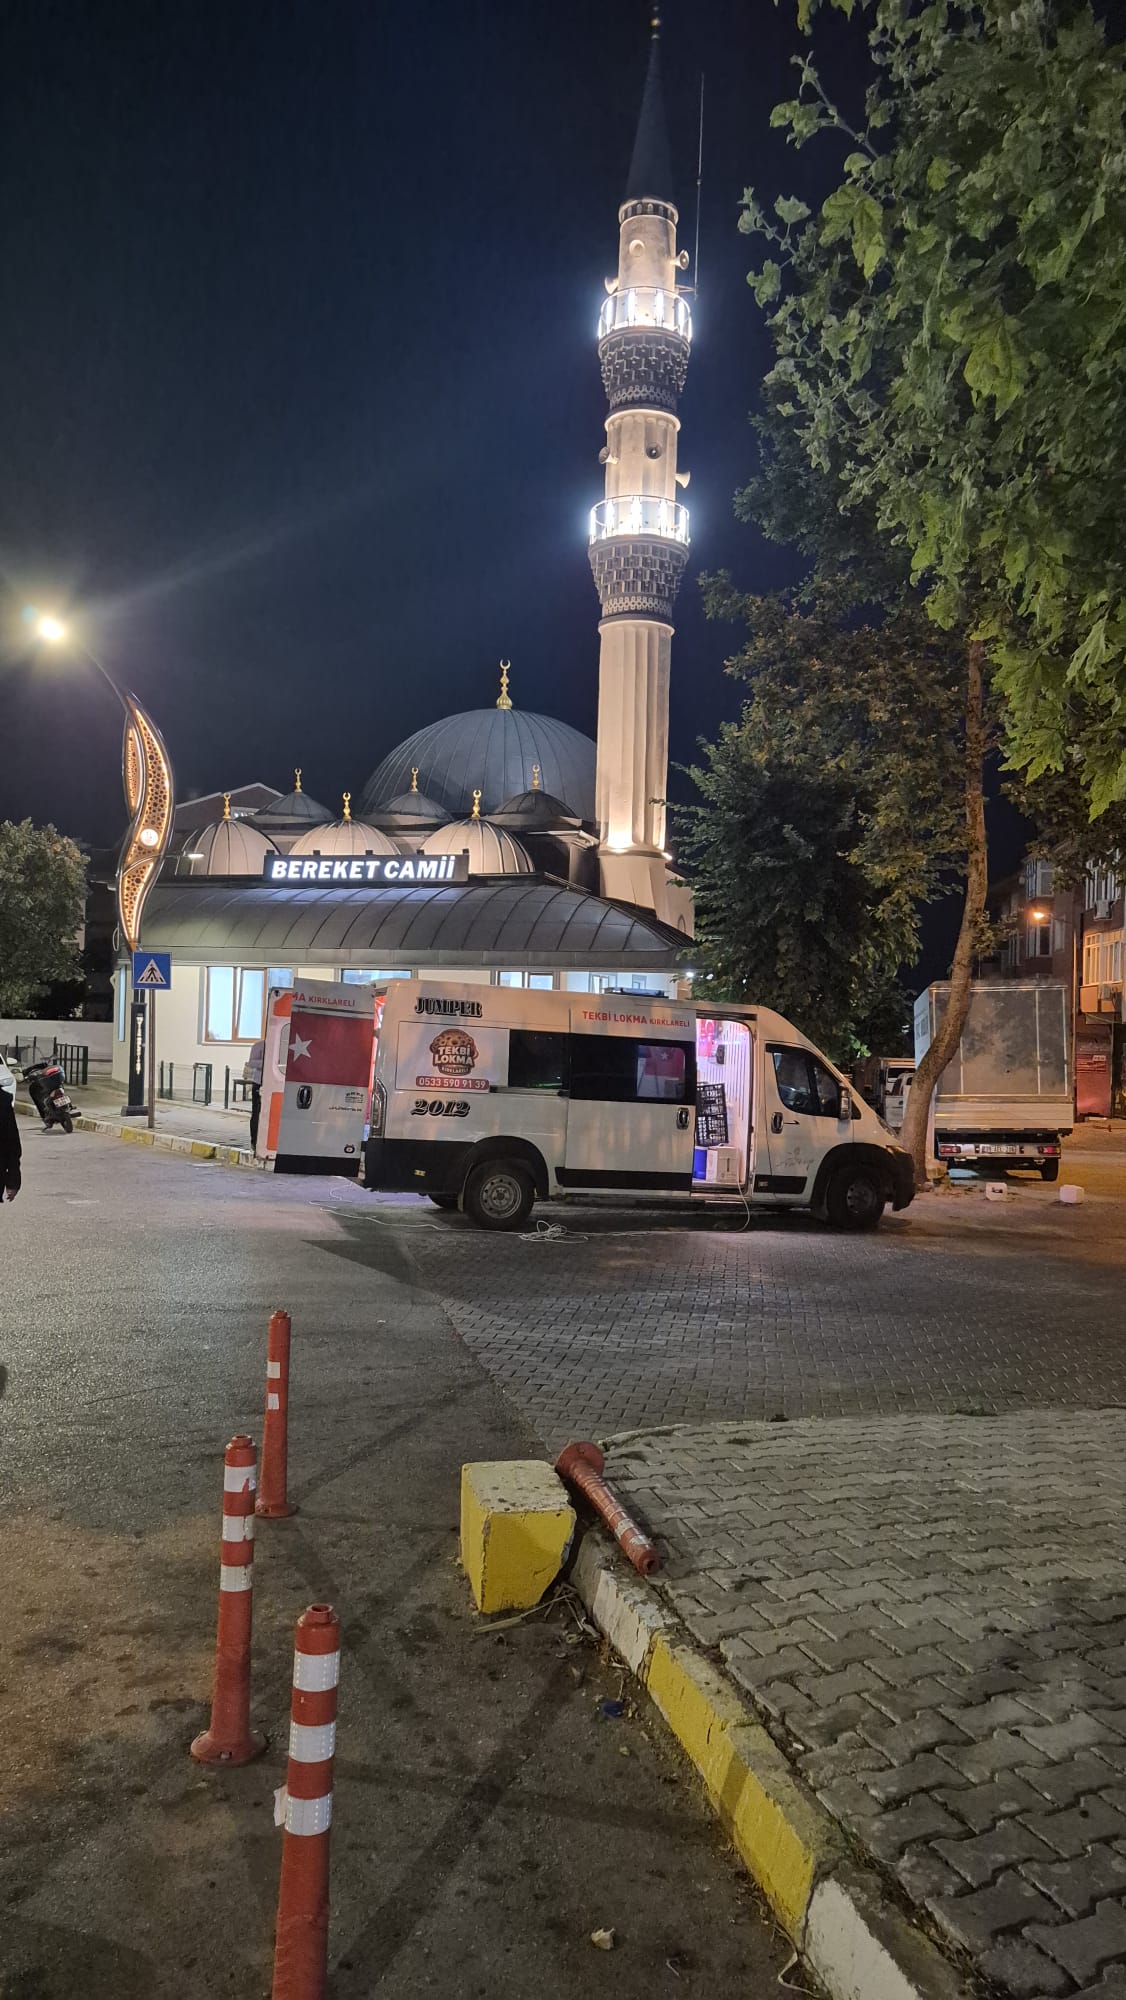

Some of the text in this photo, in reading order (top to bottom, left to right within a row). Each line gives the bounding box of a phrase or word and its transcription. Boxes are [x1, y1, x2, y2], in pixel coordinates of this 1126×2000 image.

[271, 860, 380, 879] BEREKET
[414, 997, 483, 1018] JUMPER
[582, 1010, 611, 1022] TEKBİ
[614, 1013, 647, 1025] LOKMA
[438, 1044, 471, 1056] TEKBİ
[434, 1054, 473, 1066] LOKMA
[419, 1077, 486, 1089] 0533 590 91 39
[411, 1098, 470, 1118] 2012
